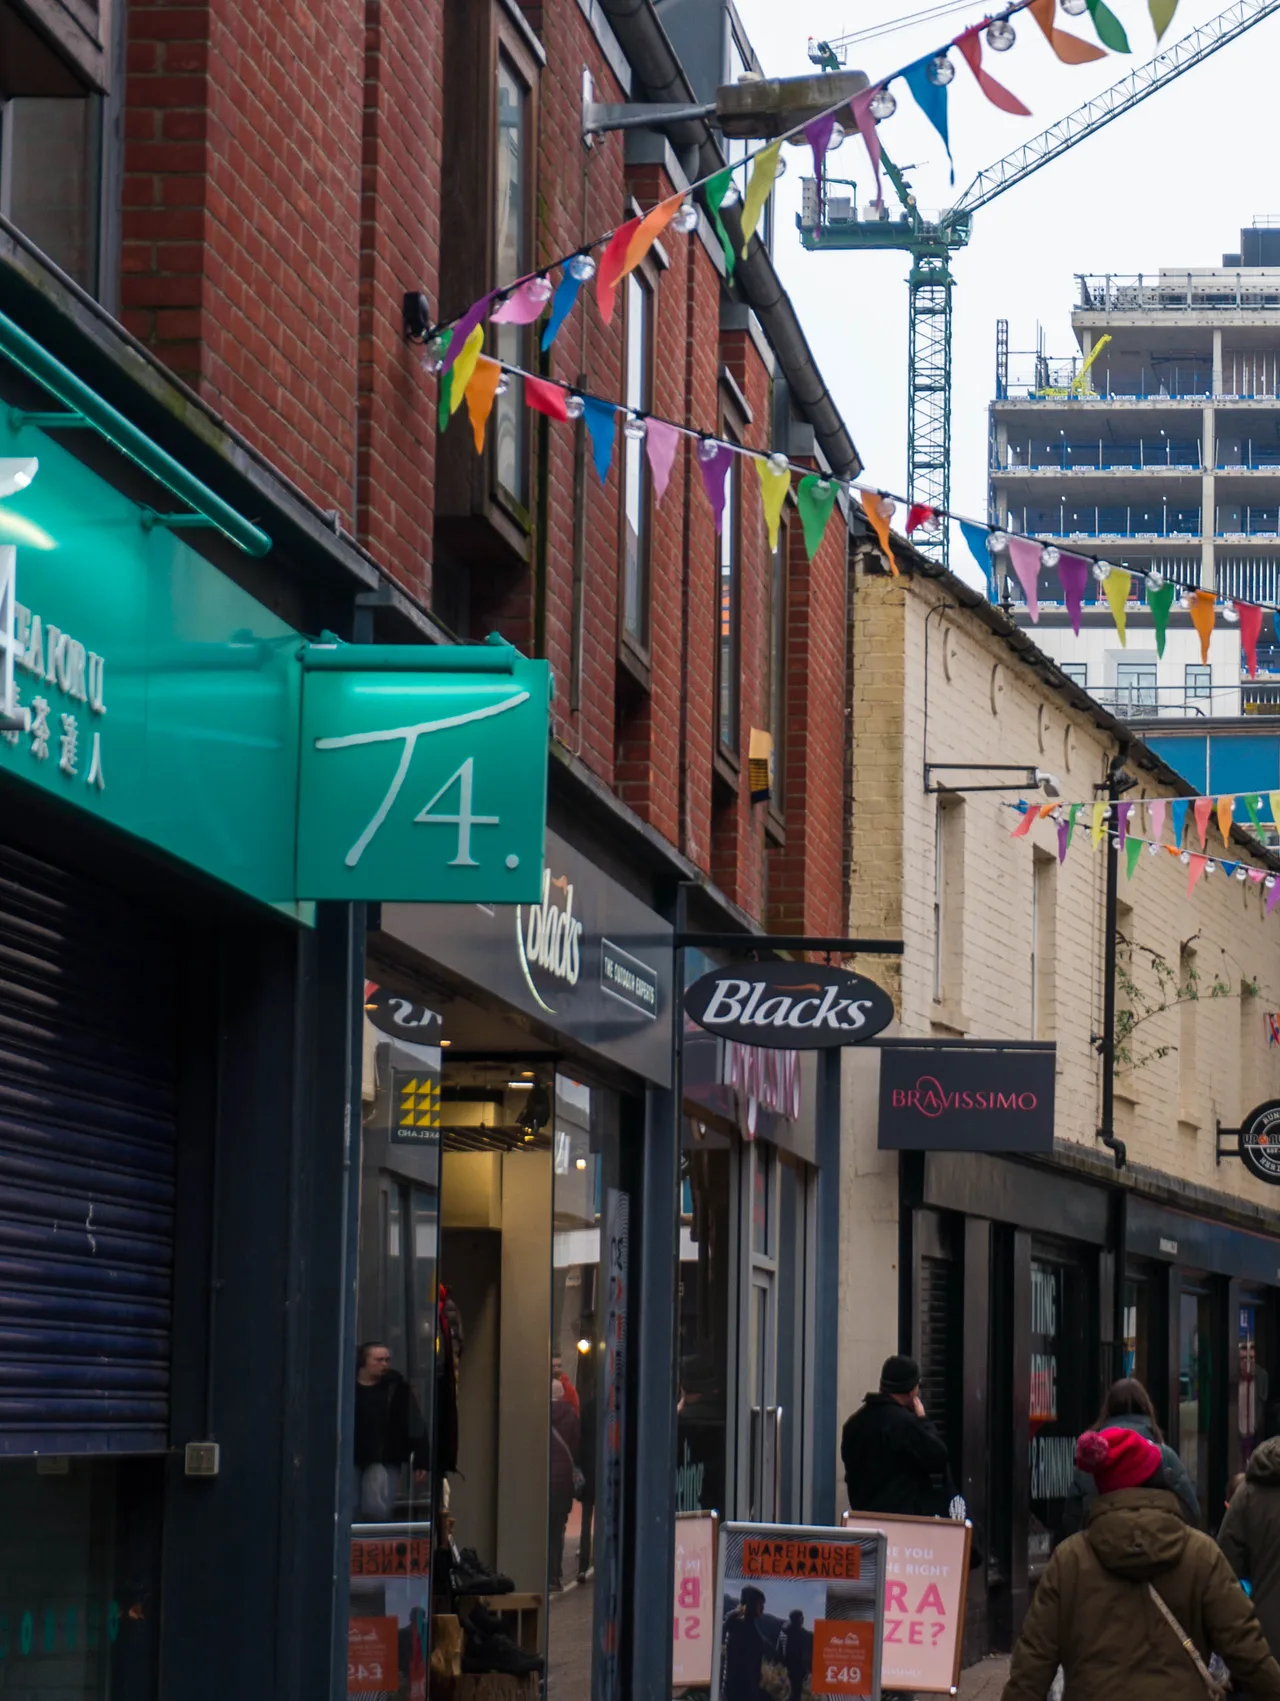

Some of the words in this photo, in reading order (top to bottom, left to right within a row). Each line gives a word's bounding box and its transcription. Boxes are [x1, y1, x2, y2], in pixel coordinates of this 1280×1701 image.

[702, 979, 873, 1030] Blacks
[892, 1075, 1037, 1118] BRAVISSIMO
[1030, 1271, 1057, 1337] TTING
[1029, 1353, 1058, 1418] ADING
[747, 1541, 857, 1562] WAREHOUSE
[904, 1547, 934, 1560] YOU
[747, 1557, 856, 1577] CLEARANCE
[906, 1564, 950, 1577] RIGHT
[884, 1579, 947, 1616] RA
[883, 1618, 946, 1647] ZE?
[825, 1665, 862, 1684] £49
